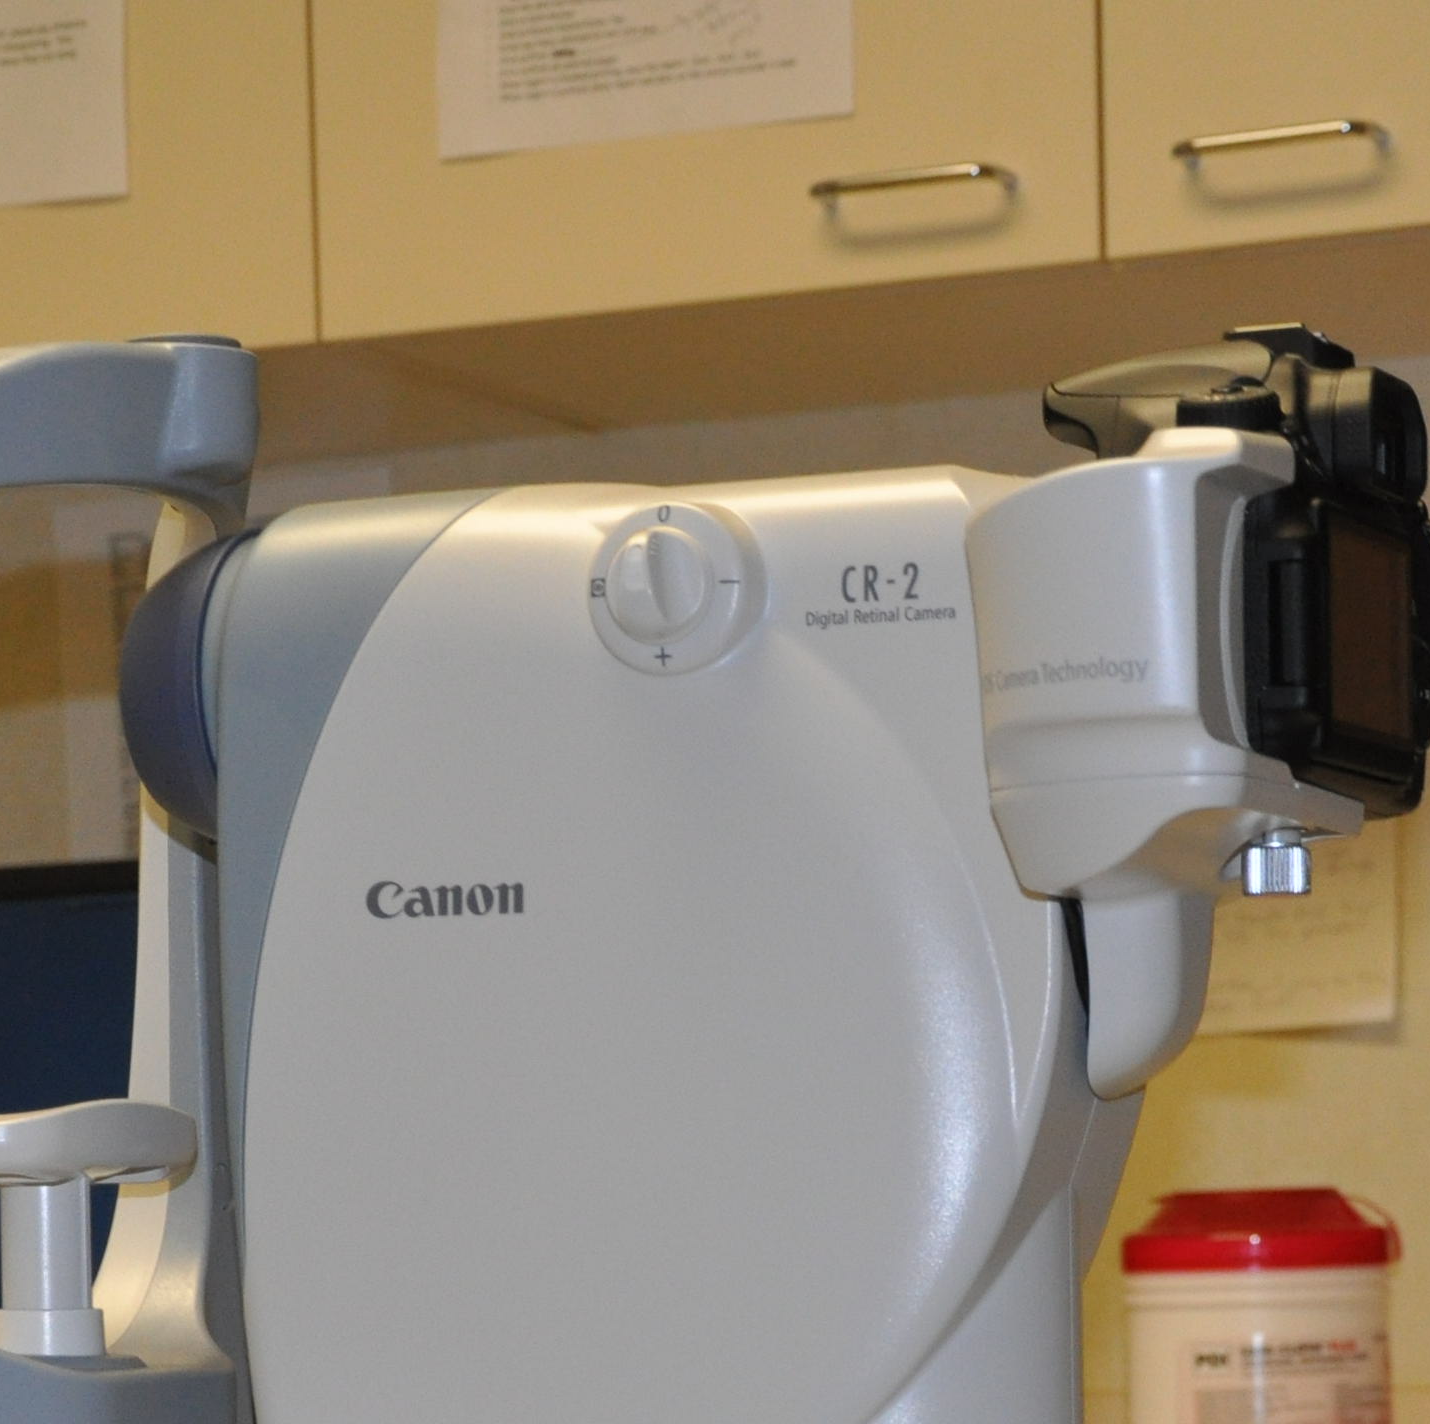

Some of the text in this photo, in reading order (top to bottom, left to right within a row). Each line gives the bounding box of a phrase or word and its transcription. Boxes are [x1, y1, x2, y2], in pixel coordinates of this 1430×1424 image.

[840, 562, 920, 603] CR-2
[805, 605, 957, 630] Digital Retinal Camera
[1041, 656, 1149, 683] Technology
[365, 880, 525, 919] Canon
